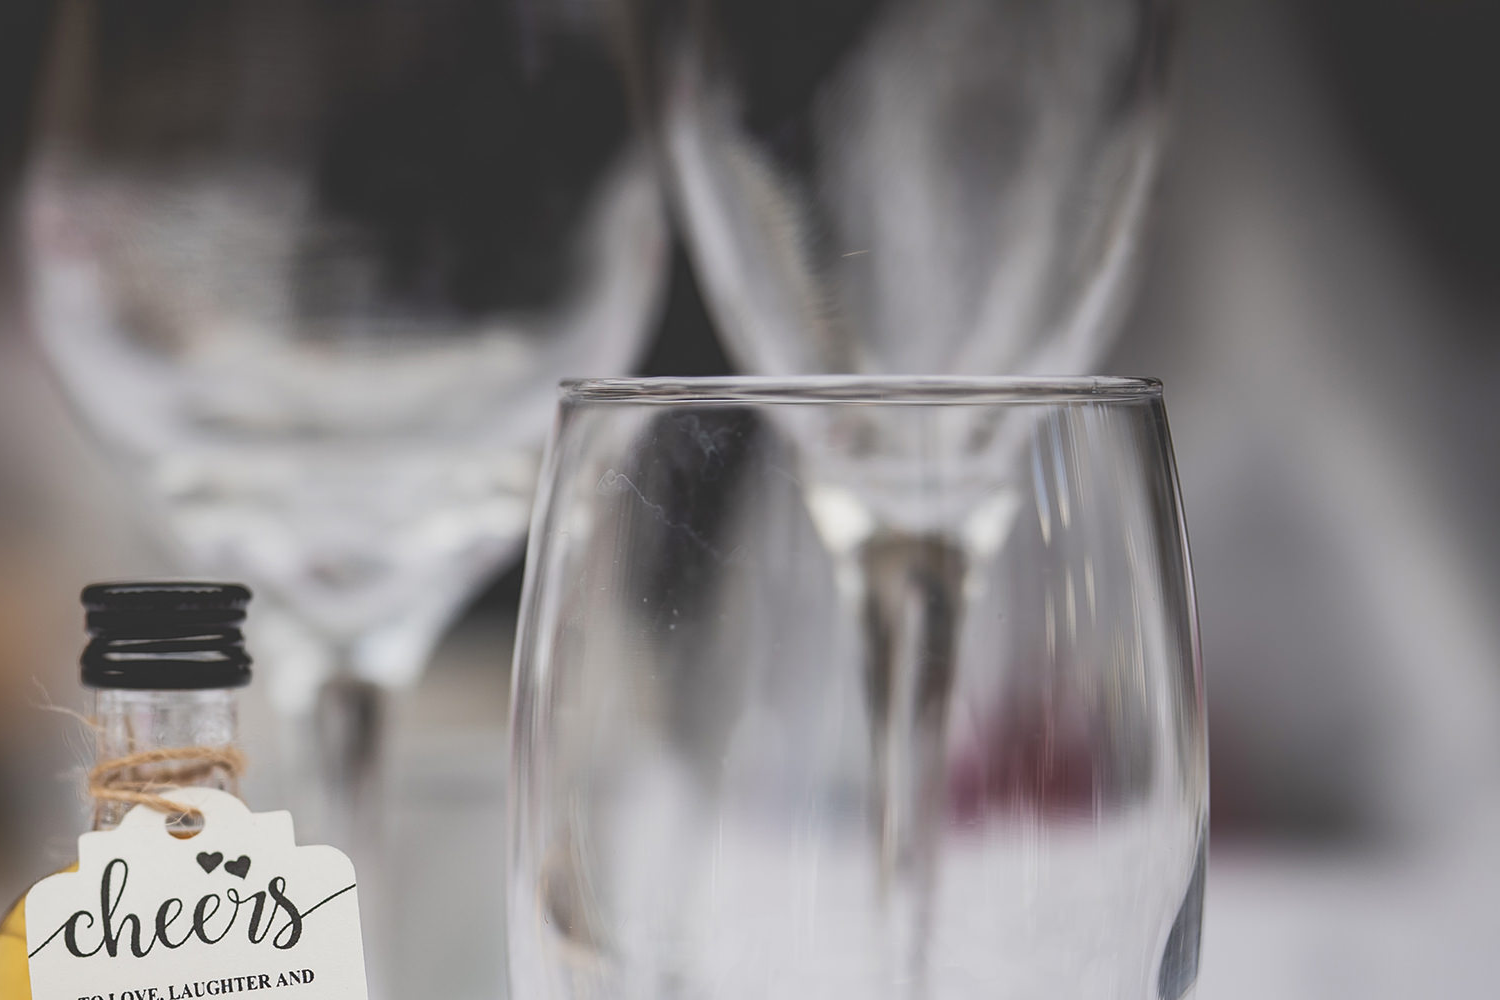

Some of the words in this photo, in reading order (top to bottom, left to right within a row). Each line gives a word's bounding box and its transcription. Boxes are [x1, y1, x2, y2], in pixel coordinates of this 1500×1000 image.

[28, 858, 356, 958] cheers
[169, 974, 271, 1000] LAUGHTER
[276, 969, 315, 988] AND
